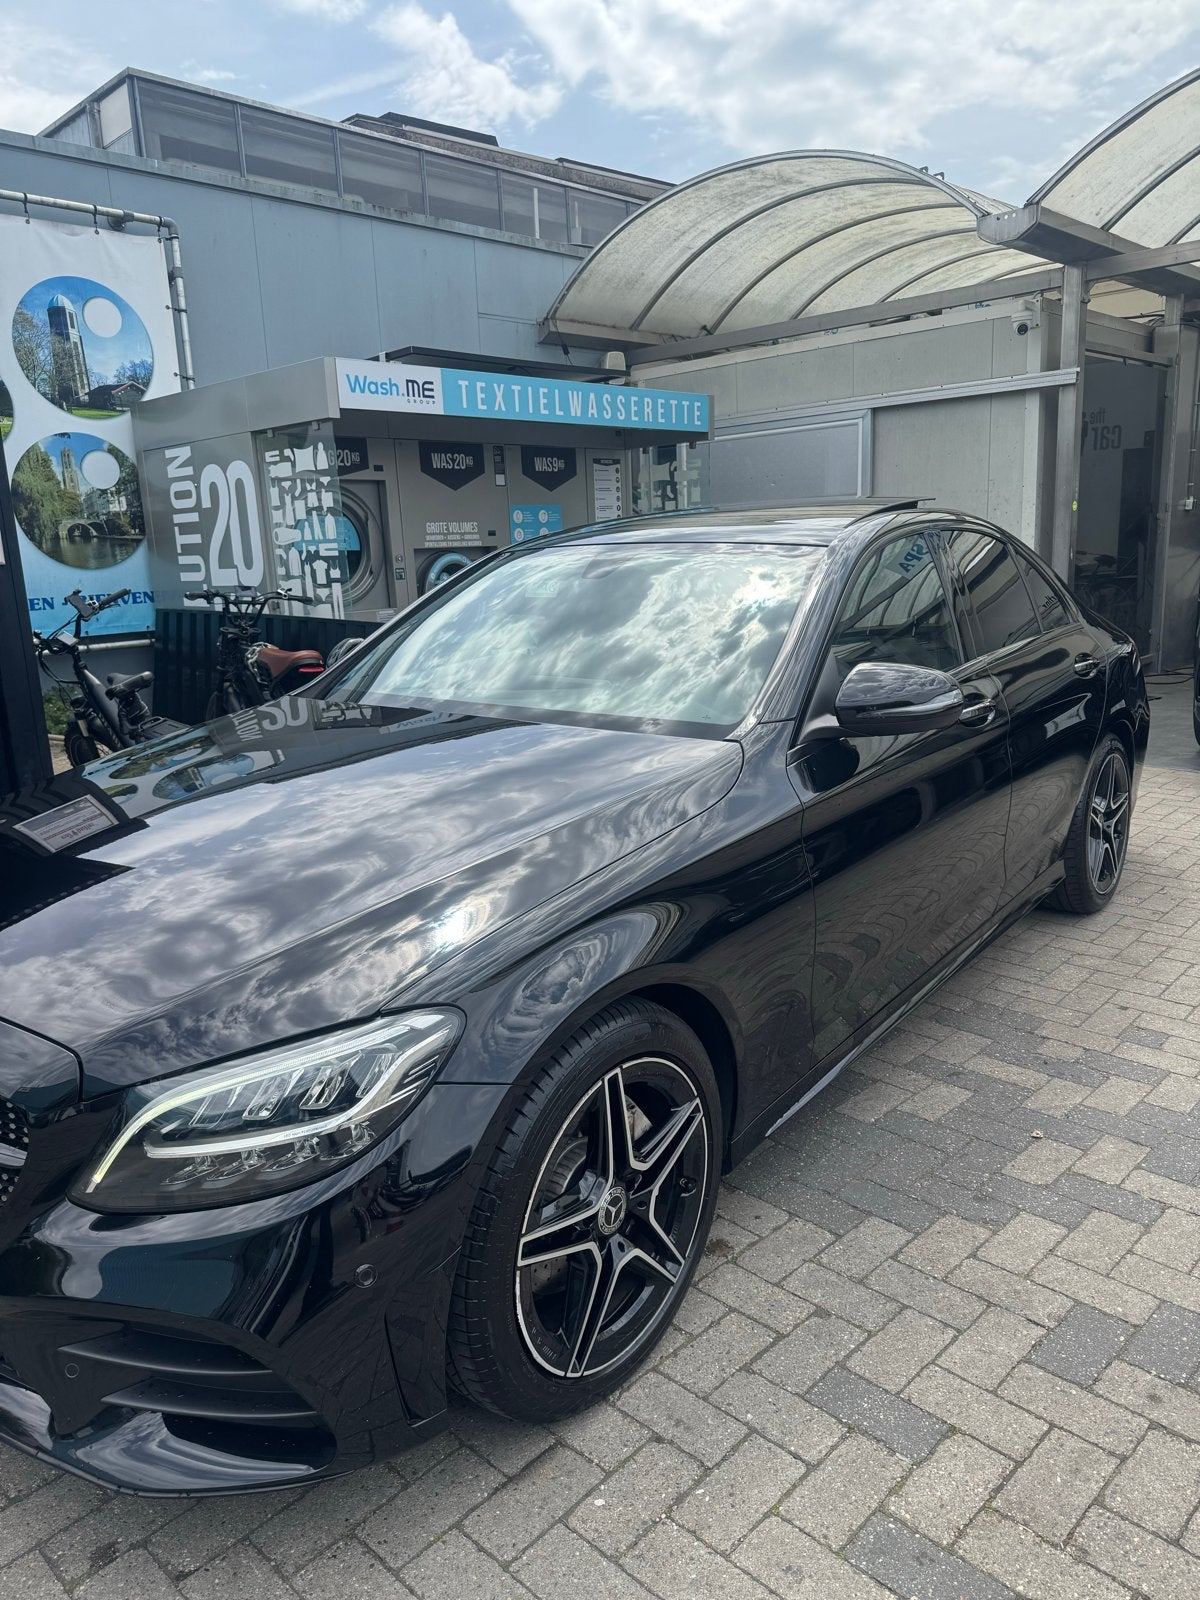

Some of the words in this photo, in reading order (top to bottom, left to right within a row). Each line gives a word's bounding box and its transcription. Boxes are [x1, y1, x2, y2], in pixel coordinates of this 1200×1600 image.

[458, 380, 702, 425] TEXTIELWASSERETTE
[200, 460, 265, 587] 20
[426, 522, 448, 533] GROTE
[448, 521, 478, 533] VOLUMES
